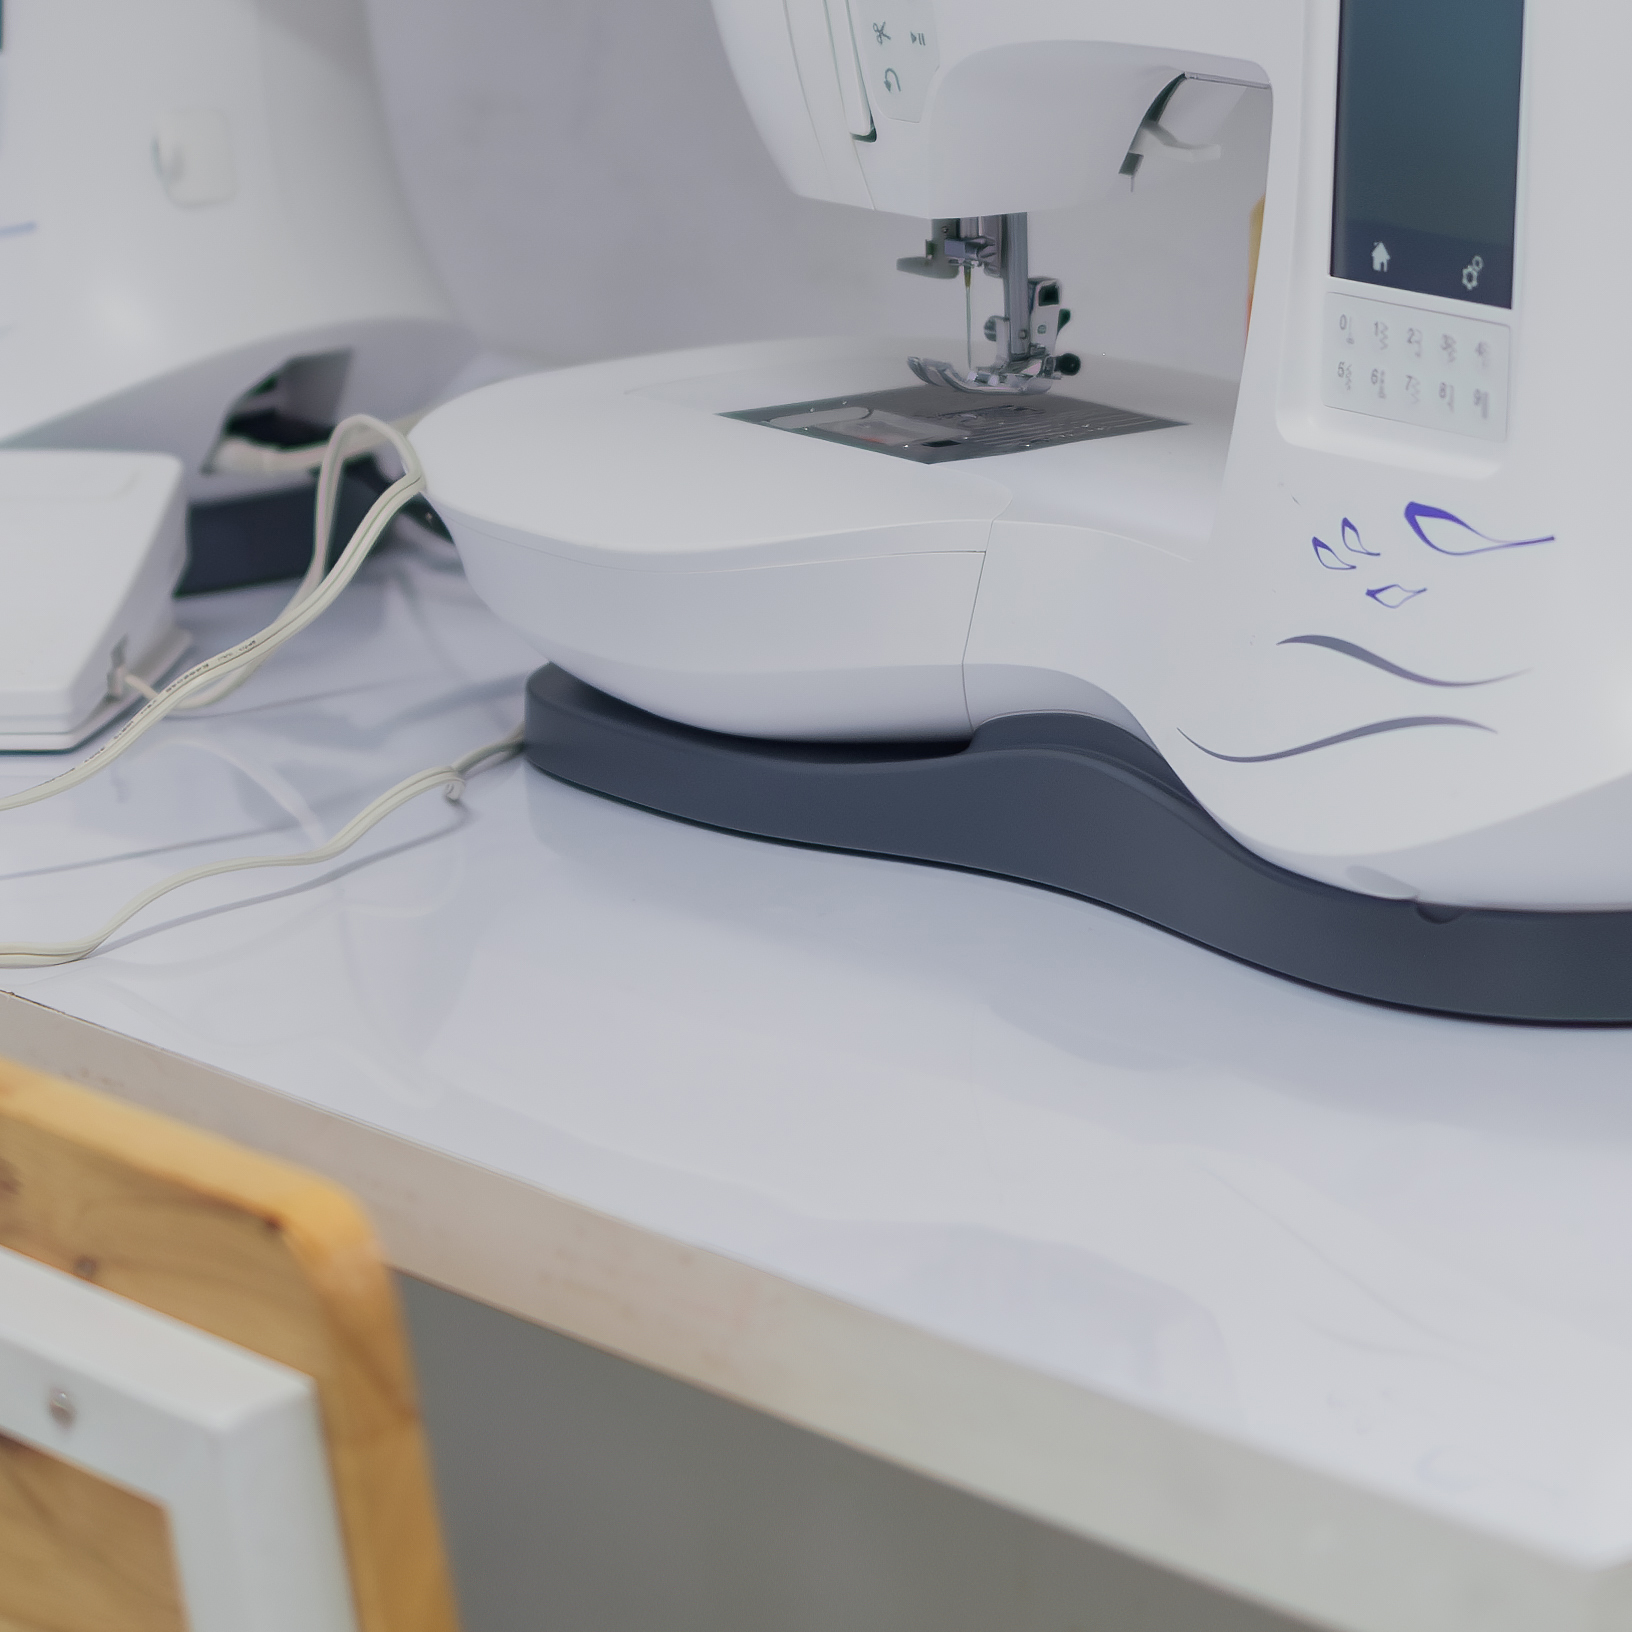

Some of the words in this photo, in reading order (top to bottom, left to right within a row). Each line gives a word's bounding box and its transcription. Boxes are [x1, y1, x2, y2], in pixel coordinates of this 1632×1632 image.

[1339, 313, 1347, 331] 0
[1407, 328, 1415, 344] 2
[1371, 368, 1378, 386] 6
[1405, 374, 1413, 391] 7
[1439, 381, 1447, 399] 8
